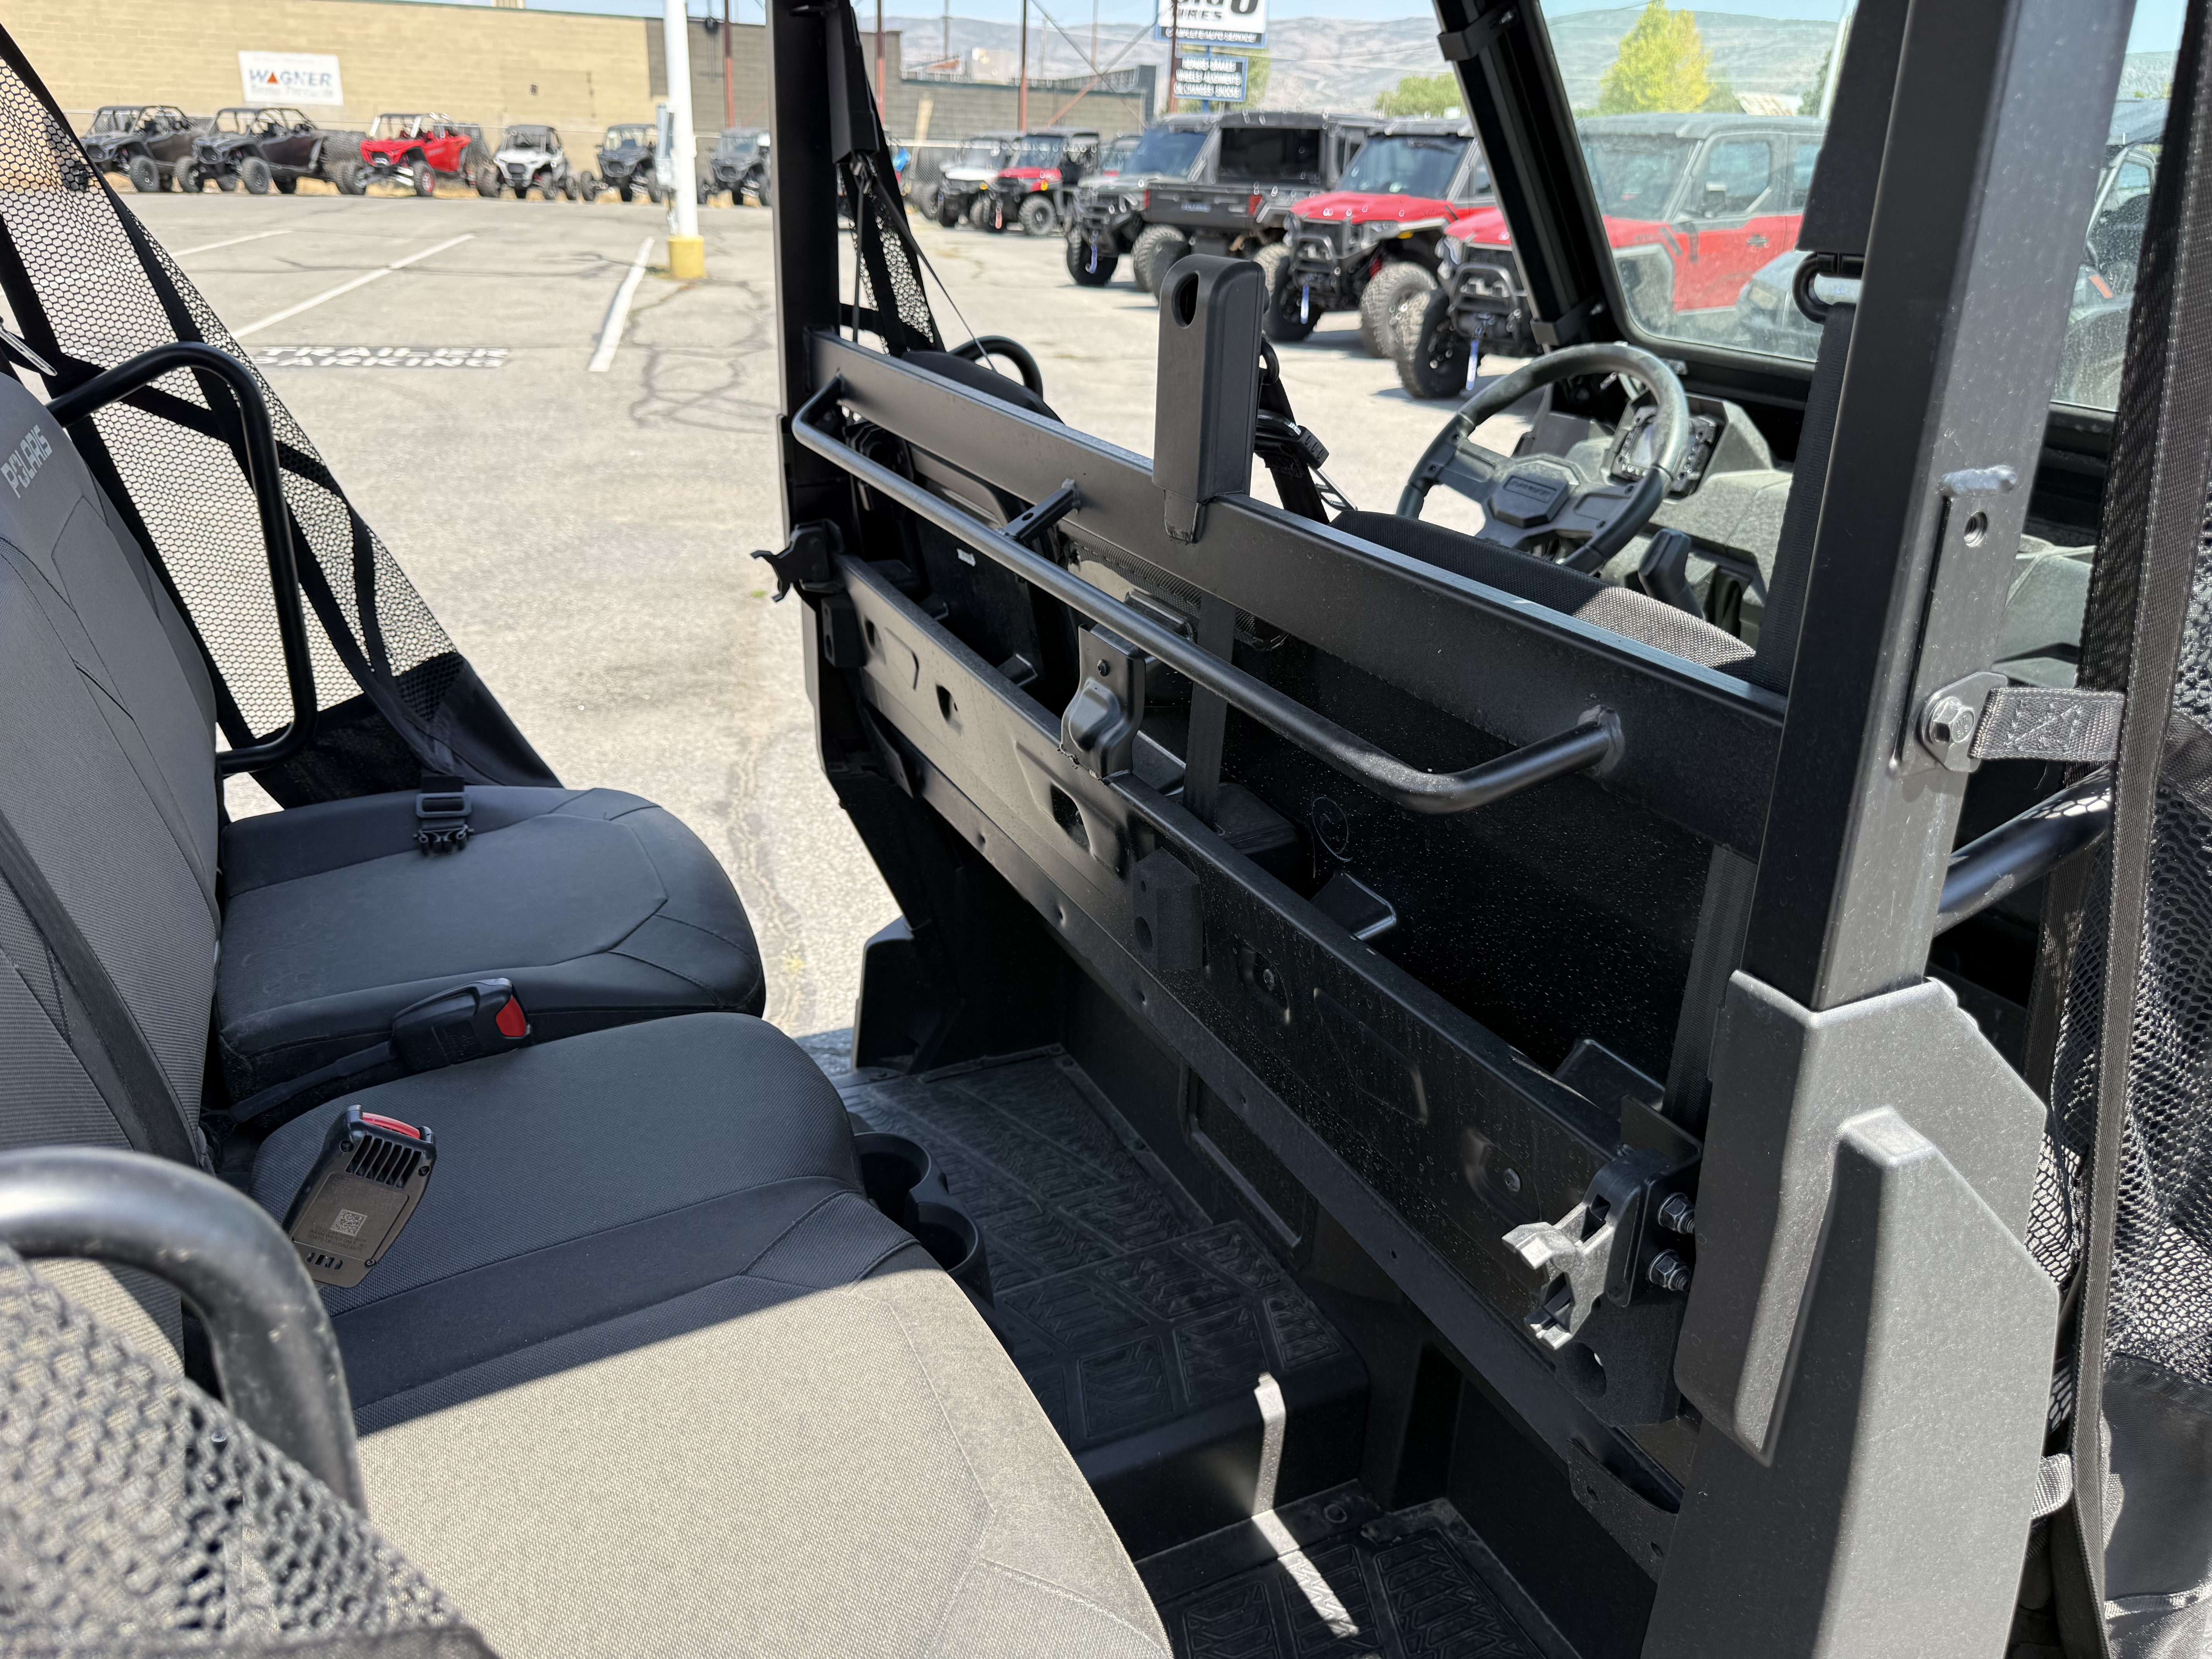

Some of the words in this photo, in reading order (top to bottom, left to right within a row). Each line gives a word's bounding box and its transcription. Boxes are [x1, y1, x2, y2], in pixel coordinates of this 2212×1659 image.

[1177, 8, 1222, 20] IRES
[249, 70, 331, 86] WAGNER
[262, 346, 509, 358] TRAILER
[249, 356, 504, 367] PARKING
[0, 424, 53, 499] POLARIS
